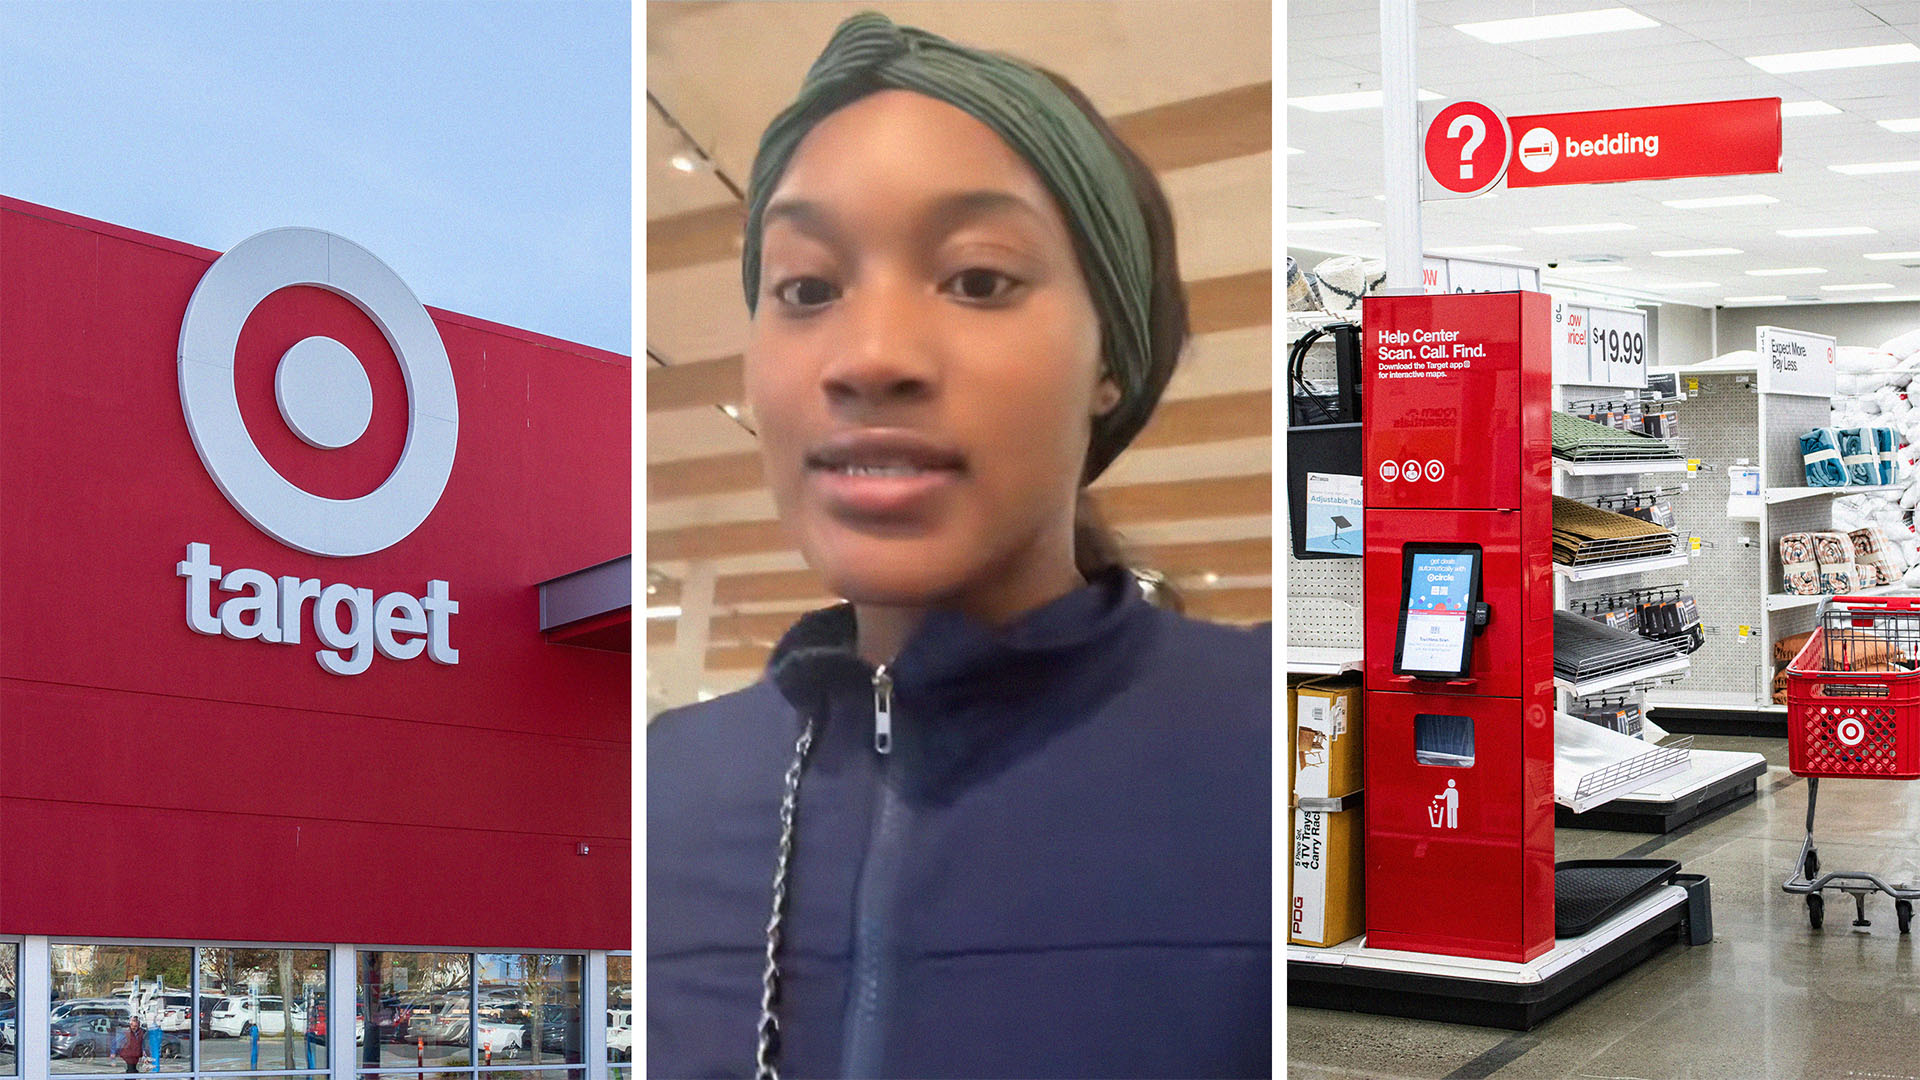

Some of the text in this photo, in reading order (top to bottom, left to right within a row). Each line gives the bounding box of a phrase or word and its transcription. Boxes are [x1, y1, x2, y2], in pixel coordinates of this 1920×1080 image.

[1565, 133, 1659, 157] bedding
[1378, 328, 1460, 346] Help Center
[1593, 327, 1644, 365] $19.99
[1378, 343, 1487, 361] Scan. Call. Find.
[1771, 339, 1791, 356] Expect
[1378, 361, 1464, 371] Download the Target app
[1772, 355, 1783, 373] Pay
[1378, 370, 1448, 379] for interactive maps.
[1310, 495, 1348, 504] Adjustable
[1418, 565, 1454, 573] automatically
[1430, 558, 1440, 566] get
[176, 541, 459, 675] target
[1301, 811, 1313, 869] 4 TV Trays
[1310, 840, 1322, 870] Carry
[1292, 896, 1304, 934] PDG
